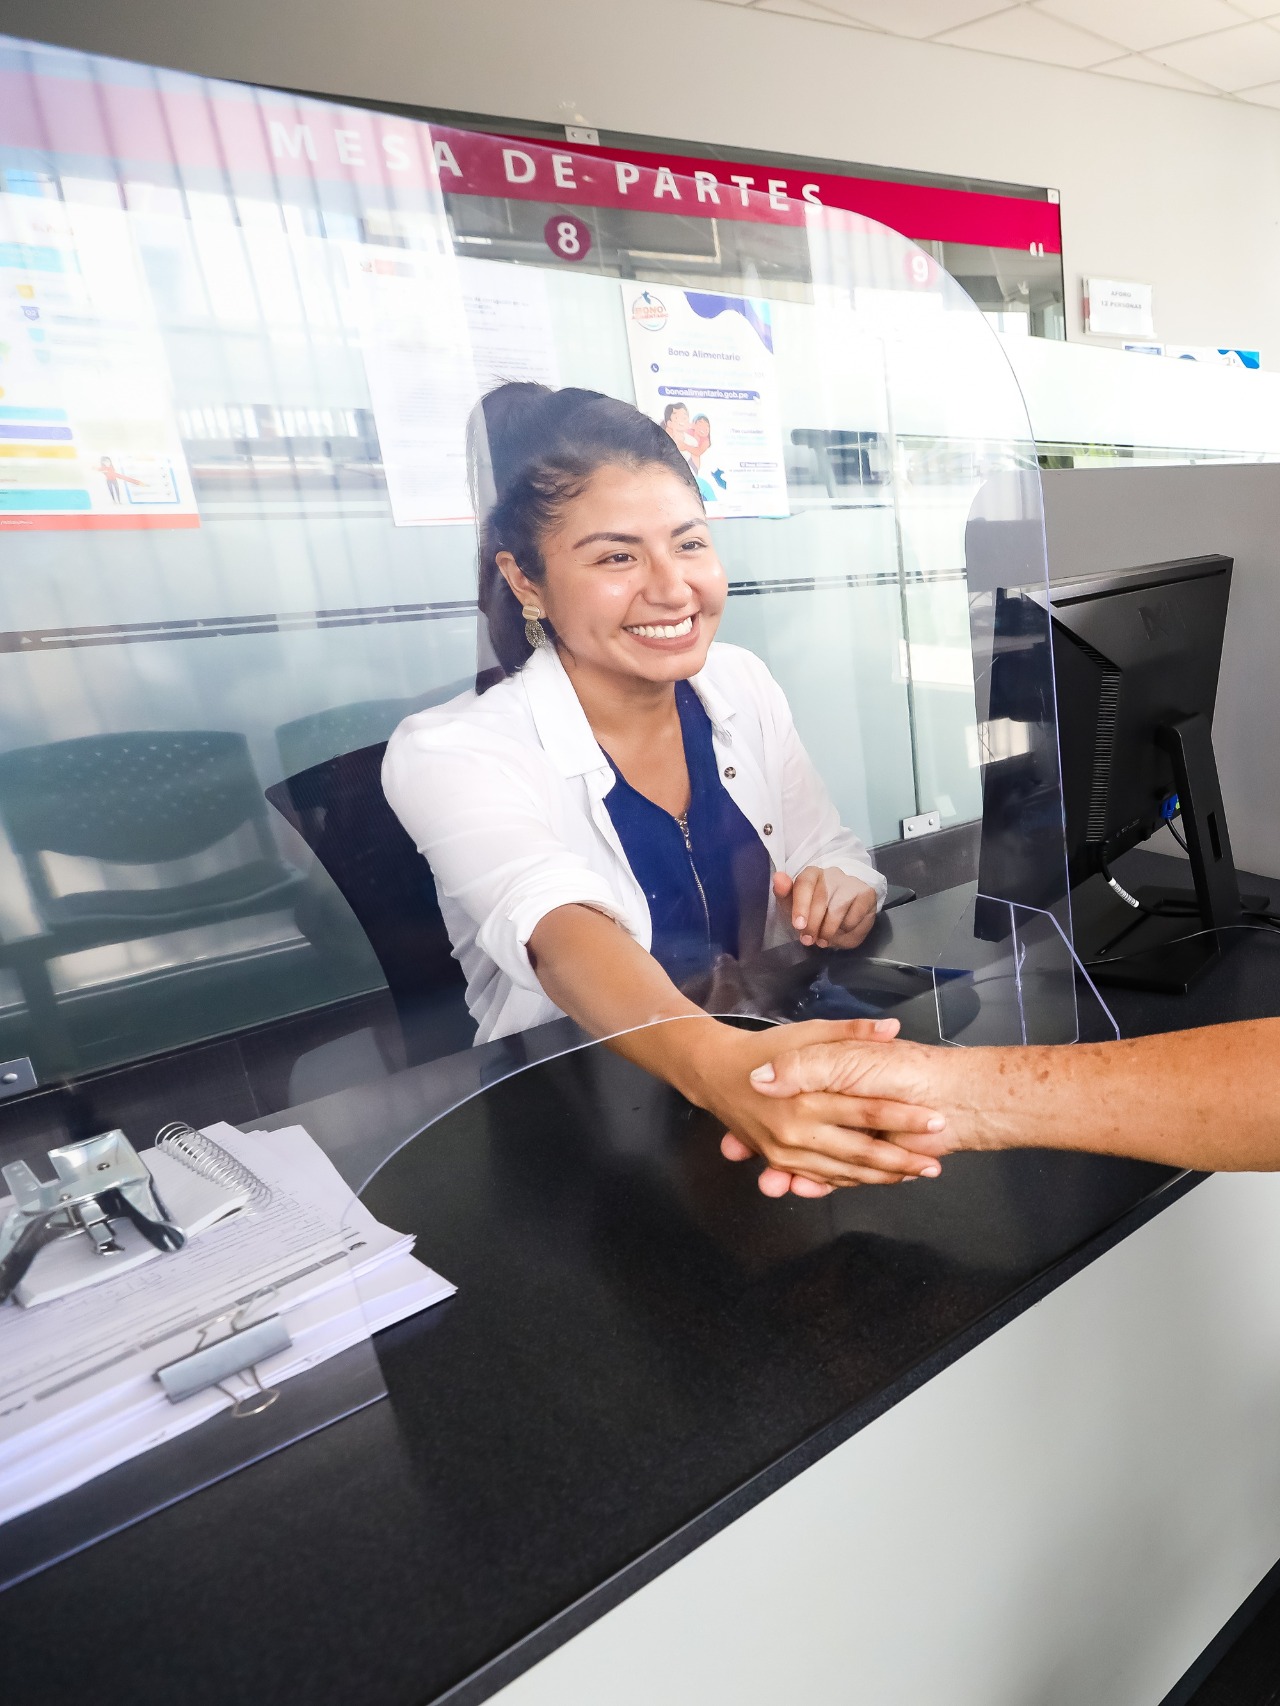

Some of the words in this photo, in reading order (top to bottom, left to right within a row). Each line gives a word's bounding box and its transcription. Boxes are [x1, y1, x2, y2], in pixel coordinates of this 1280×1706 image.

[269, 120, 463, 177] MESA
[502, 148, 577, 189] DE
[614, 161, 823, 213] PARTES
[557, 222, 580, 254] 8
[911, 255, 929, 282] 9
[668, 347, 690, 357] Bono
[692, 349, 741, 362] Alimentario
[665, 387, 749, 400] bonoalimentario.gob.pe
